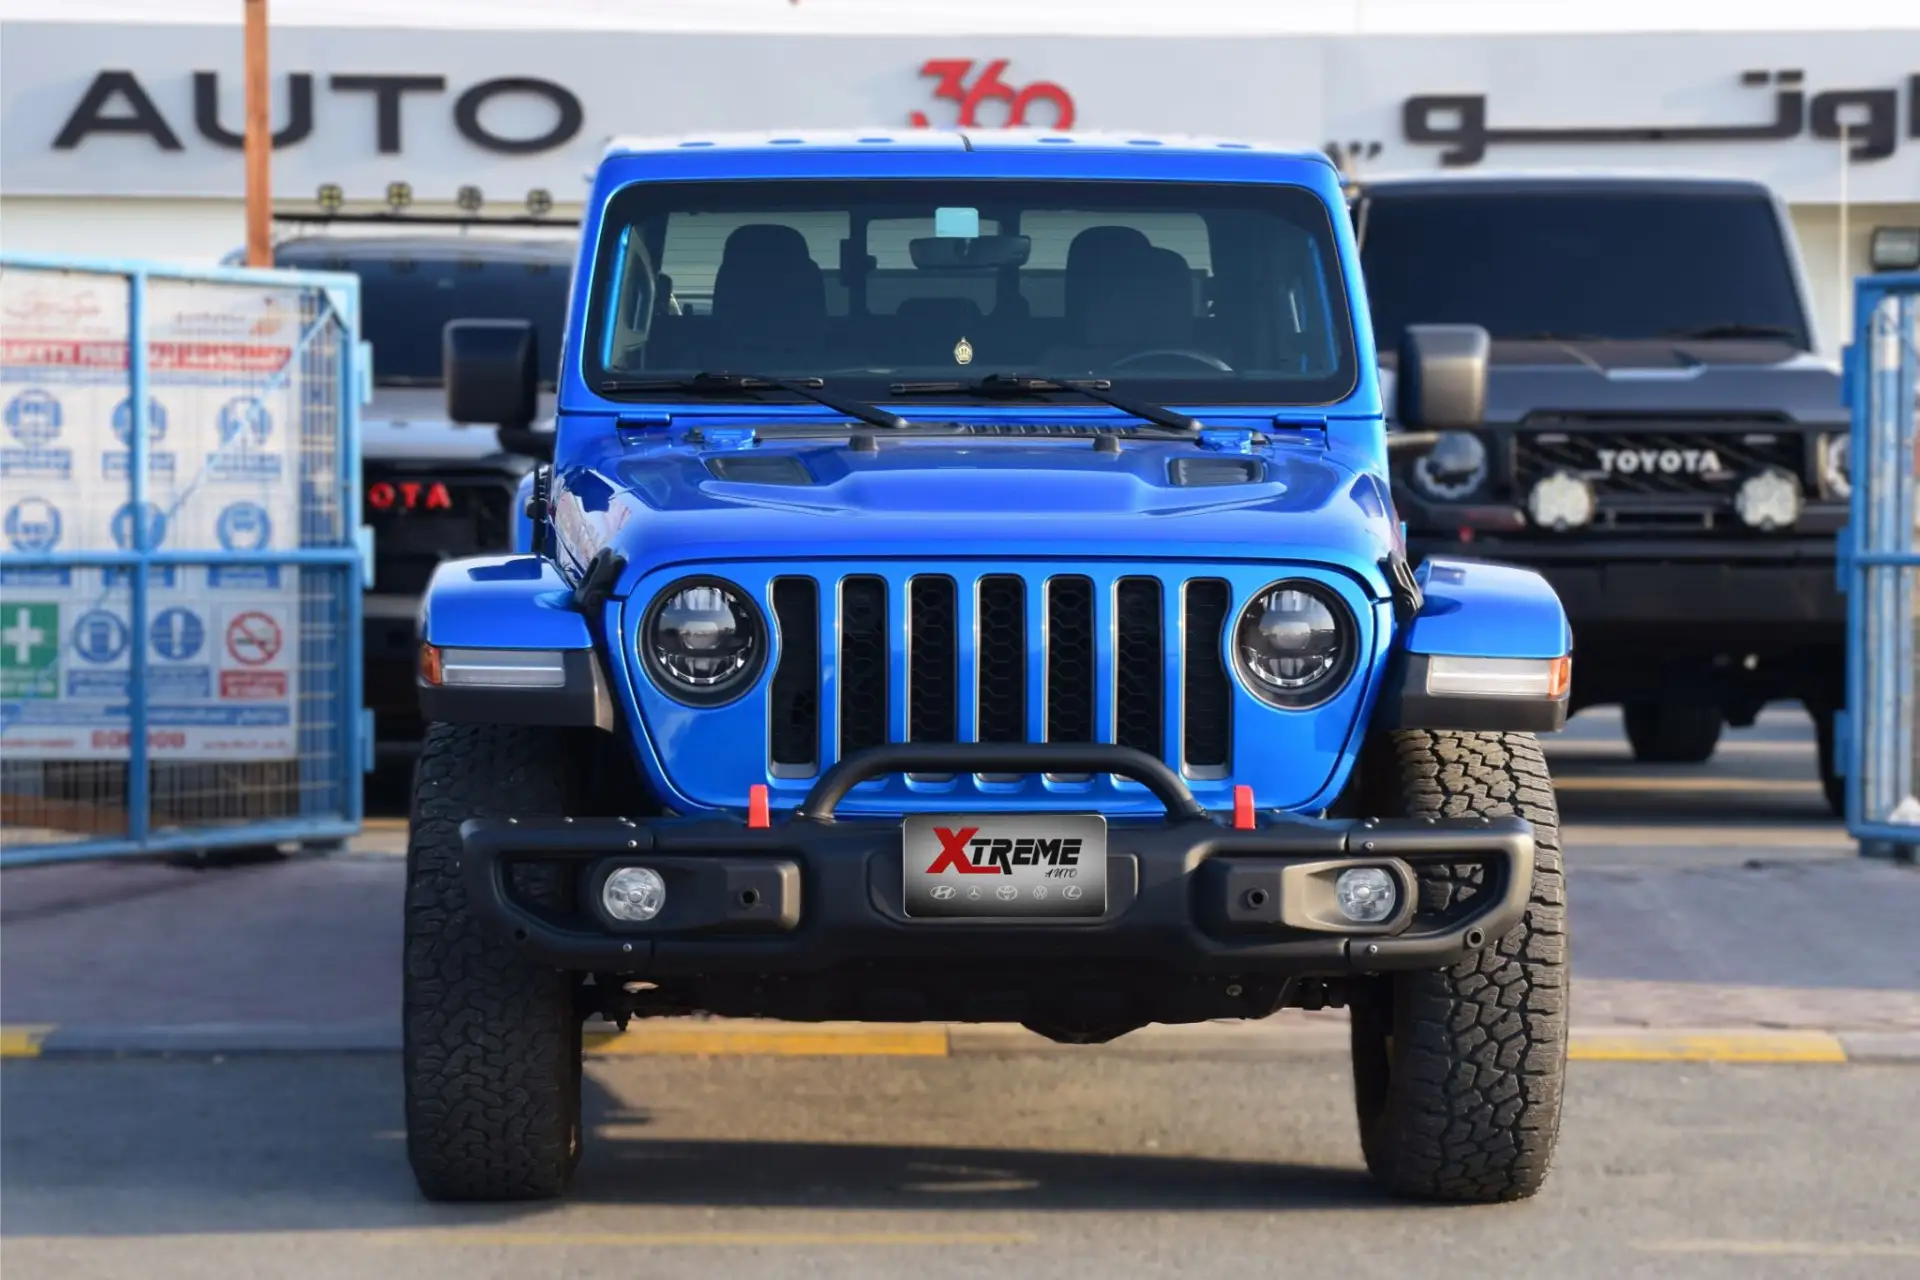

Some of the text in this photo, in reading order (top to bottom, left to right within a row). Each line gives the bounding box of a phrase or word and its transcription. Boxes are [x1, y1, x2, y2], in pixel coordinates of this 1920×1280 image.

[51, 69, 585, 156] AUTO
[910, 58, 1076, 130] 360
[1596, 449, 1722, 474] TOYOTA
[368, 481, 453, 510] OTA
[925, 826, 1083, 876] XTREME
[1044, 867, 1077, 879] AUTO
